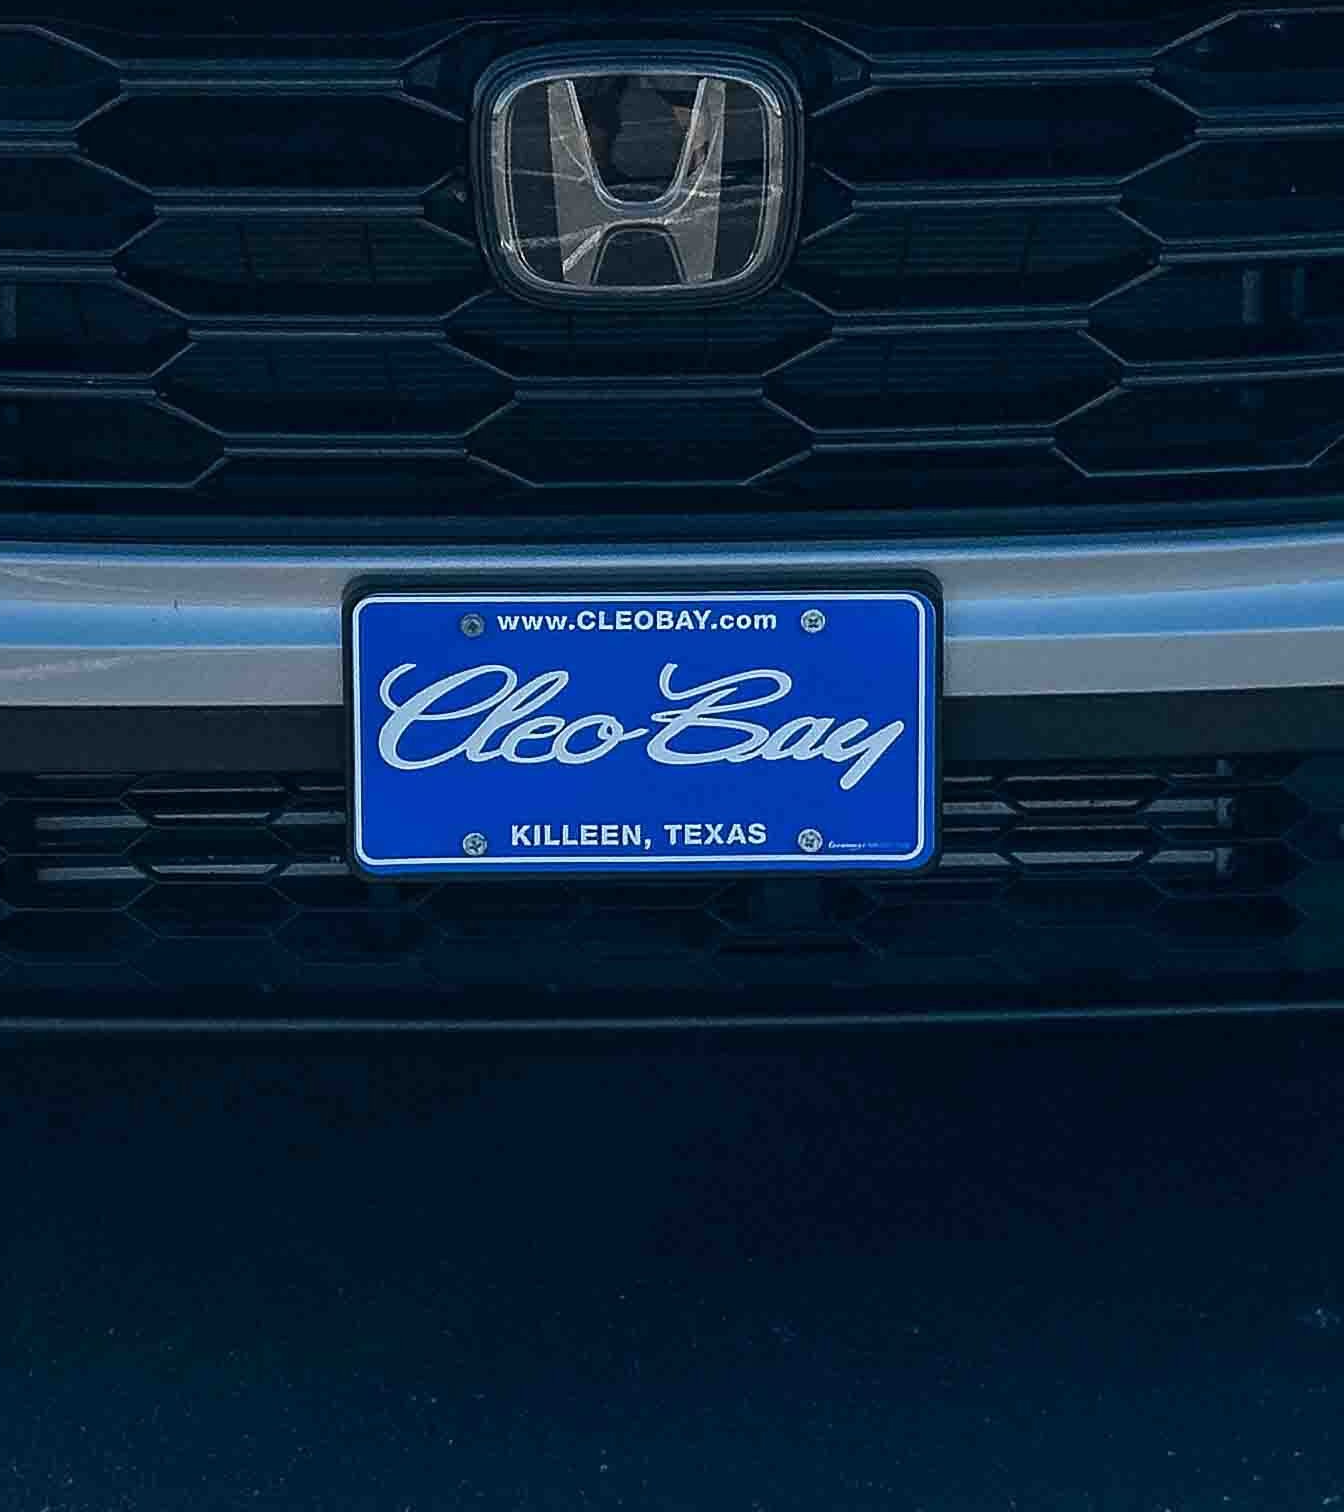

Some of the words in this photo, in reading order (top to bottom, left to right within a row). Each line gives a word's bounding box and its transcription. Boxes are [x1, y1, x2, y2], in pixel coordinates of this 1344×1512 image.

[496, 609, 777, 631] www.CLEOBAY.com
[378, 662, 650, 771] Cleo
[646, 662, 905, 790] Bay
[511, 823, 652, 850] KILLEEN,
[663, 822, 767, 846] TEXAS
